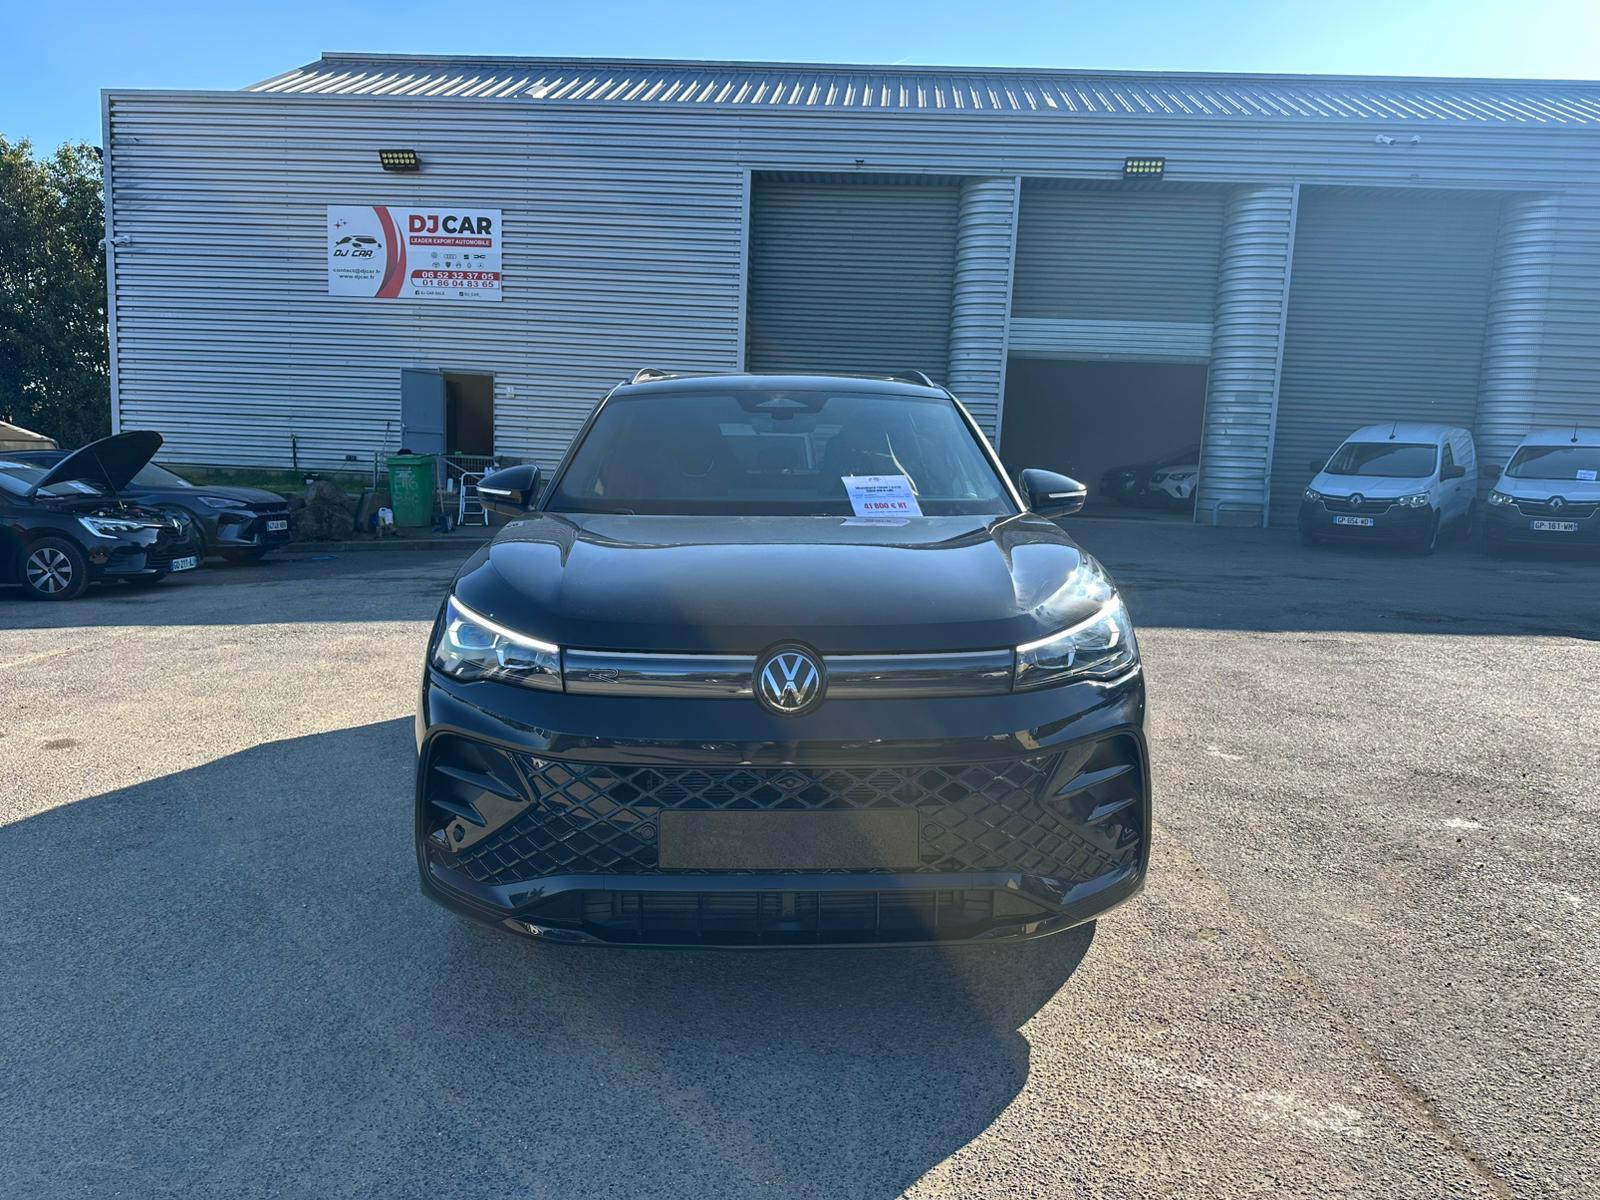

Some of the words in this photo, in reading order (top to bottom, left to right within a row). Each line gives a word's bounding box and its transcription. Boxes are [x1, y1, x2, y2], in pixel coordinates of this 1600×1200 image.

[333, 249, 349, 257] DJ
[351, 249, 373, 257] CAR
[437, 271, 449, 279] 52
